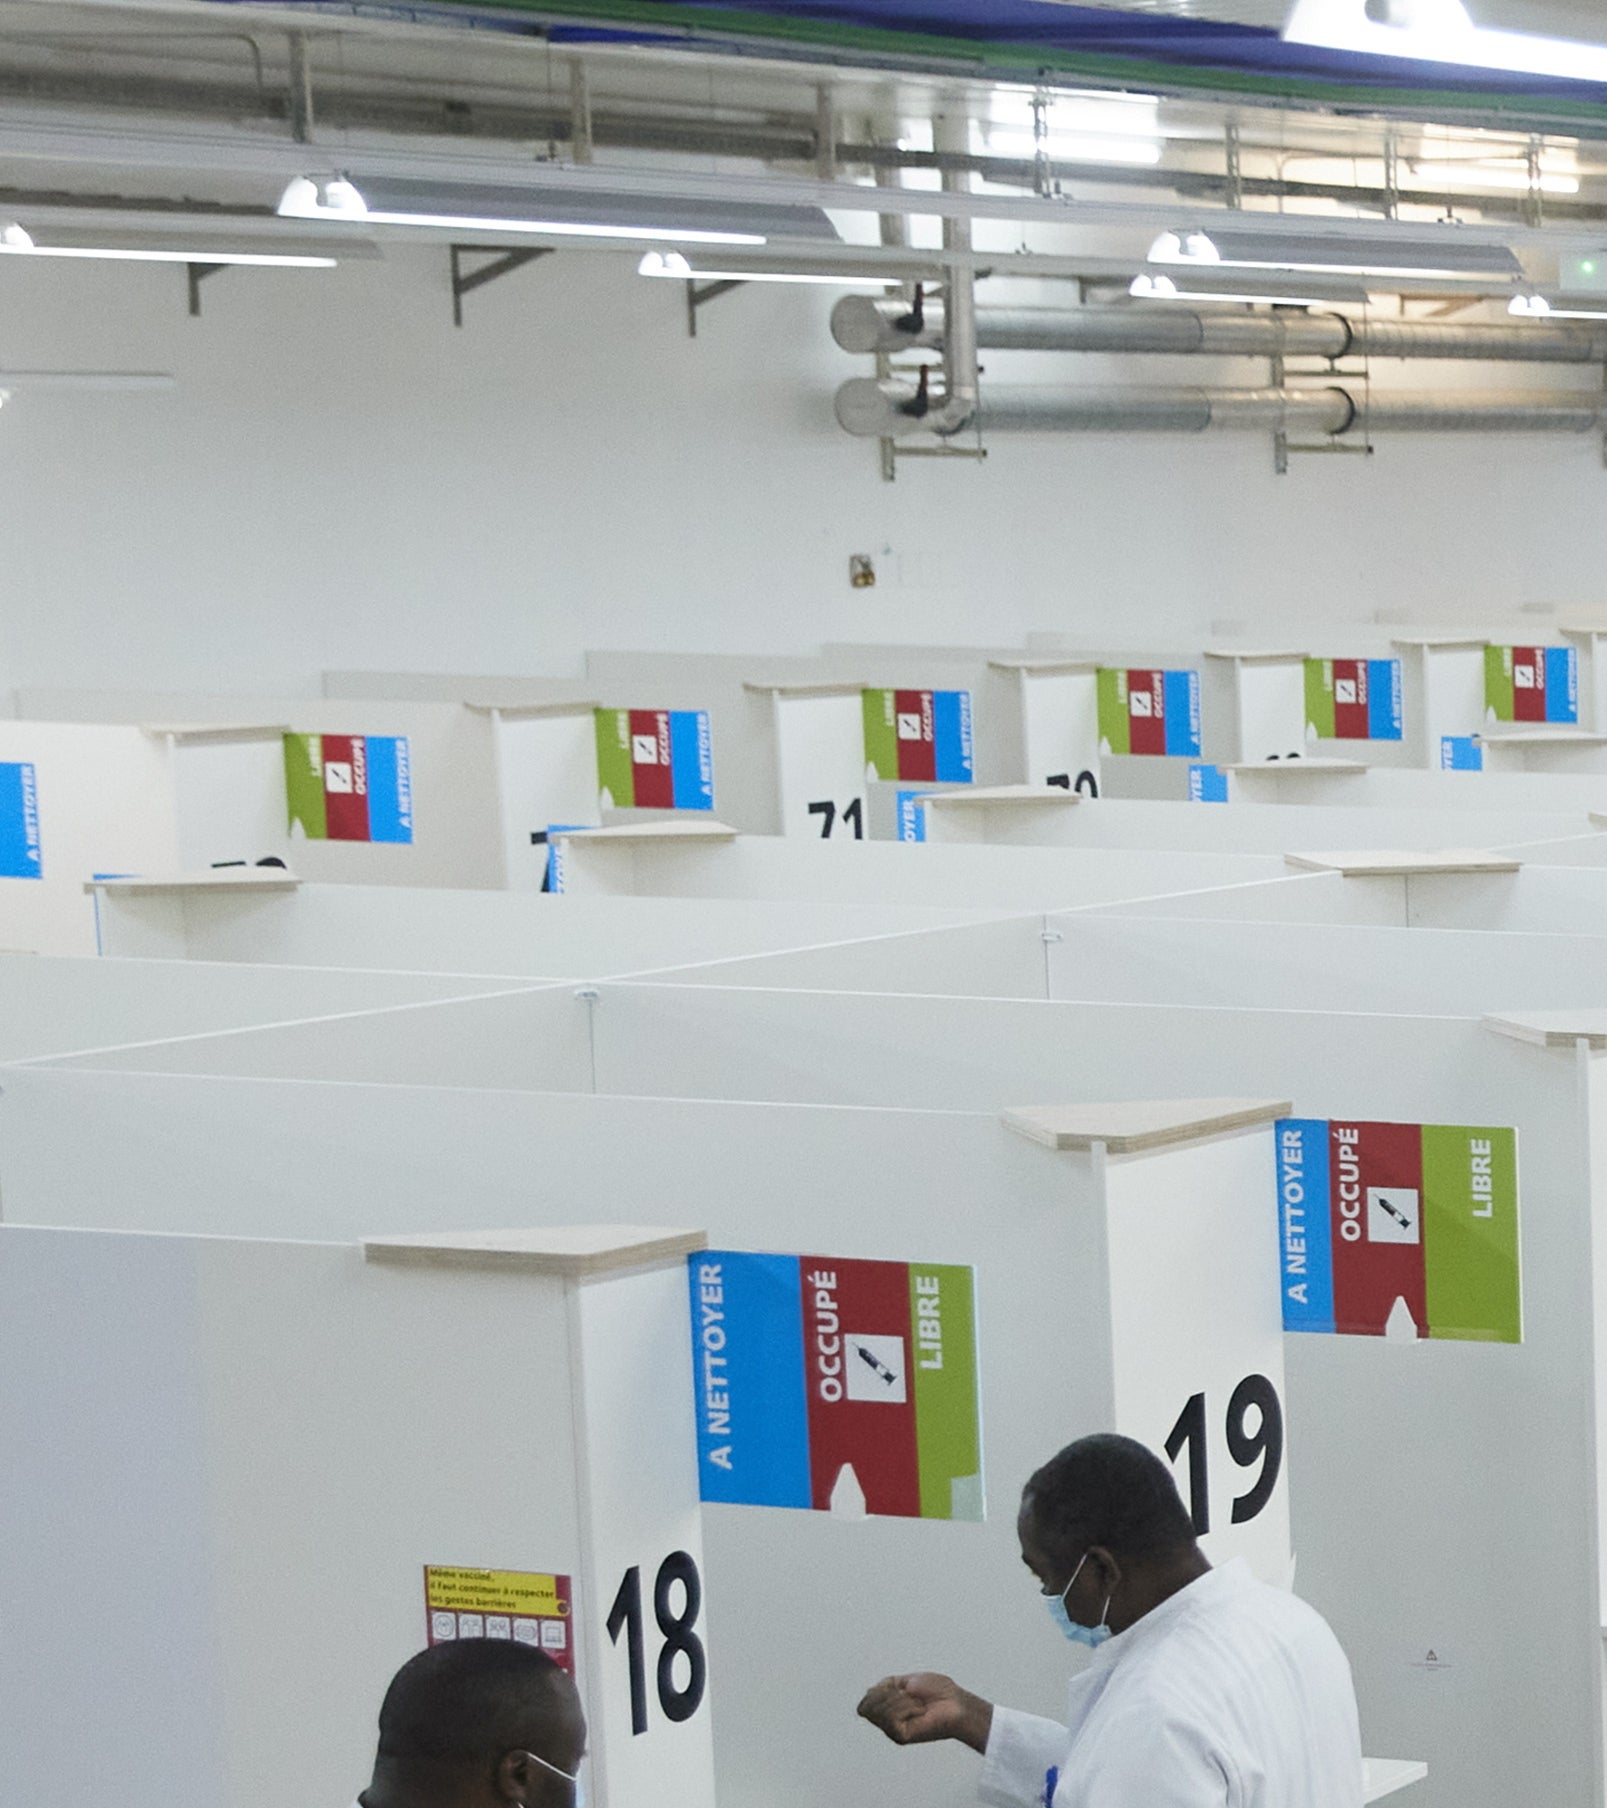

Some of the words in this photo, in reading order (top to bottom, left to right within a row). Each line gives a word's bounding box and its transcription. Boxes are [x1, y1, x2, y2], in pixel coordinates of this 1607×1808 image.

[808, 797, 863, 841] 71
[1283, 1129, 1306, 1277] NETTOYER
[1332, 1127, 1360, 1242] OCCUPÉ
[1470, 1138, 1493, 1219] LIBRE
[806, 1269, 843, 1403] OCCUPÉ
[915, 1275, 943, 1370] LIBRE
[1287, 1283, 1308, 1304] A
[700, 1262, 731, 1436] NETTOYER
[709, 1445, 733, 1471] A
[1163, 1373, 1284, 1538] 19
[445, 1596, 474, 1606] gestes
[510, 1588, 555, 1599] respecter
[606, 1549, 707, 1737] 18
